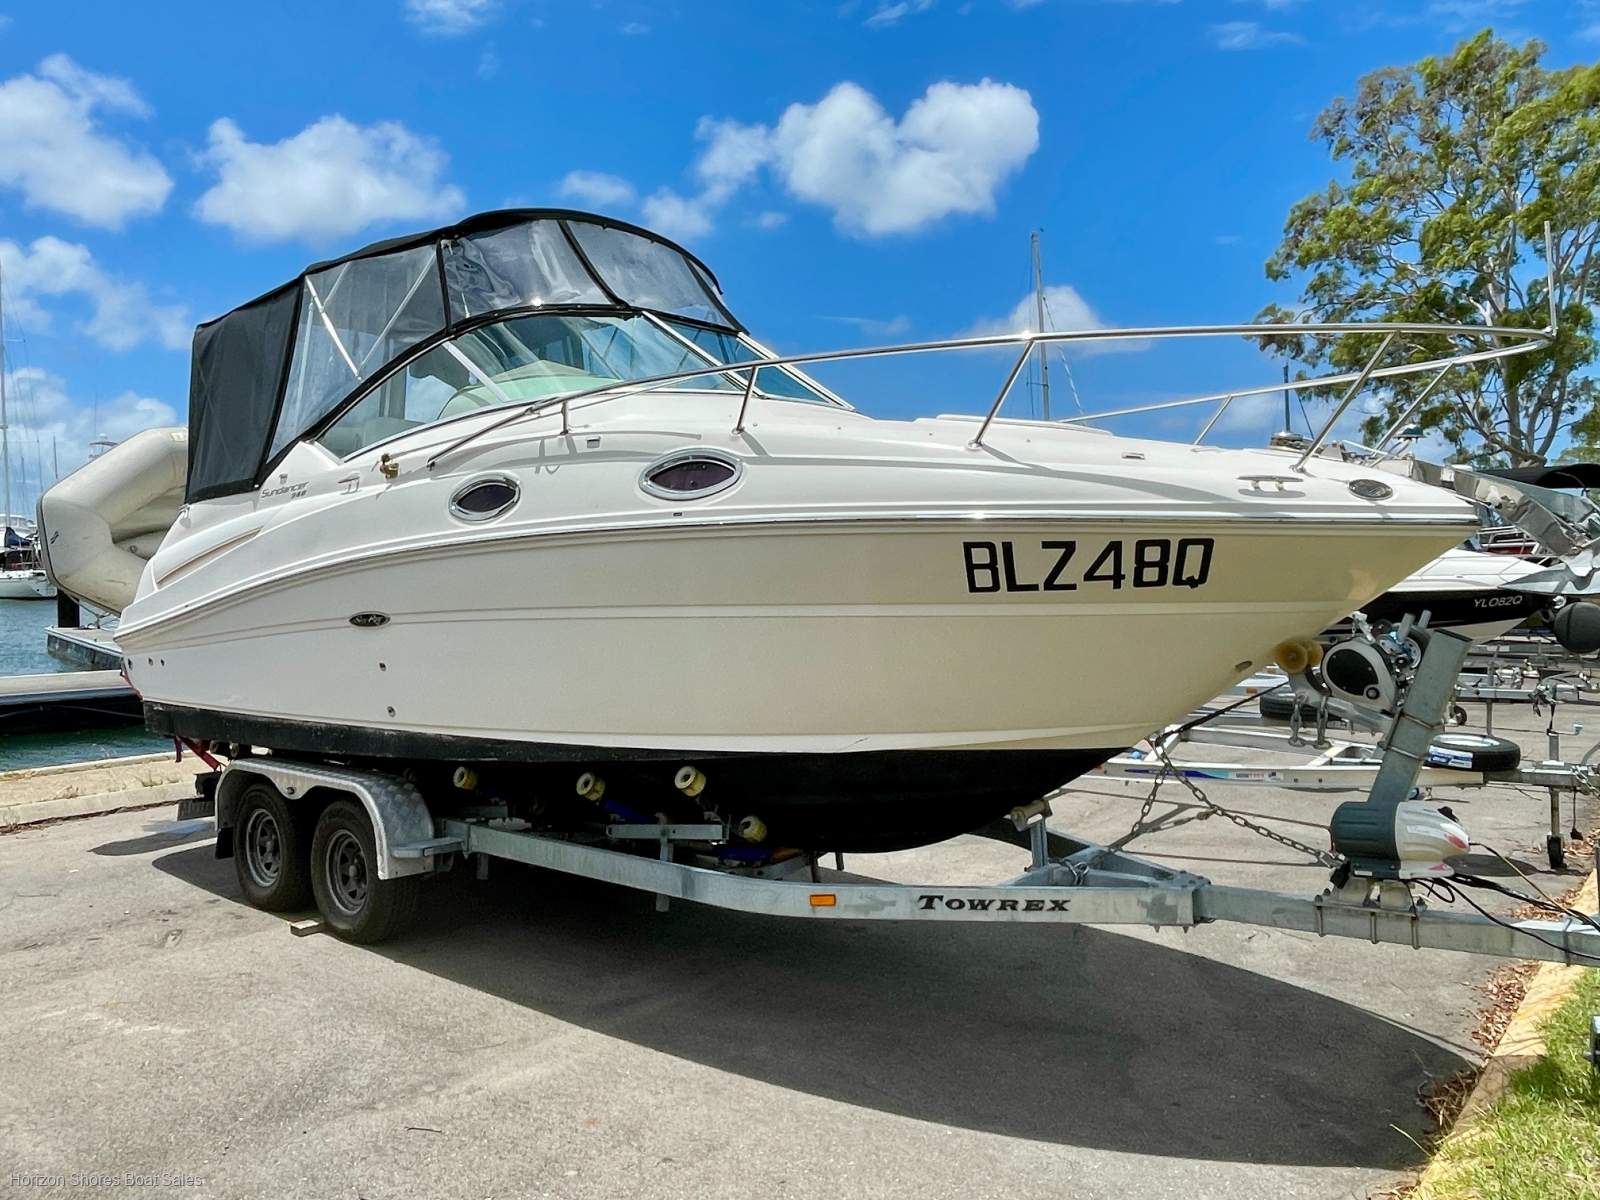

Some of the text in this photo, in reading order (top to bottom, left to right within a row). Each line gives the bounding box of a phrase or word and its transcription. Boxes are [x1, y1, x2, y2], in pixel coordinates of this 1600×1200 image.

[261, 481, 310, 498] Sundancer
[963, 538, 1214, 593] BLZ48Q
[918, 895, 1071, 912] TOWREX
